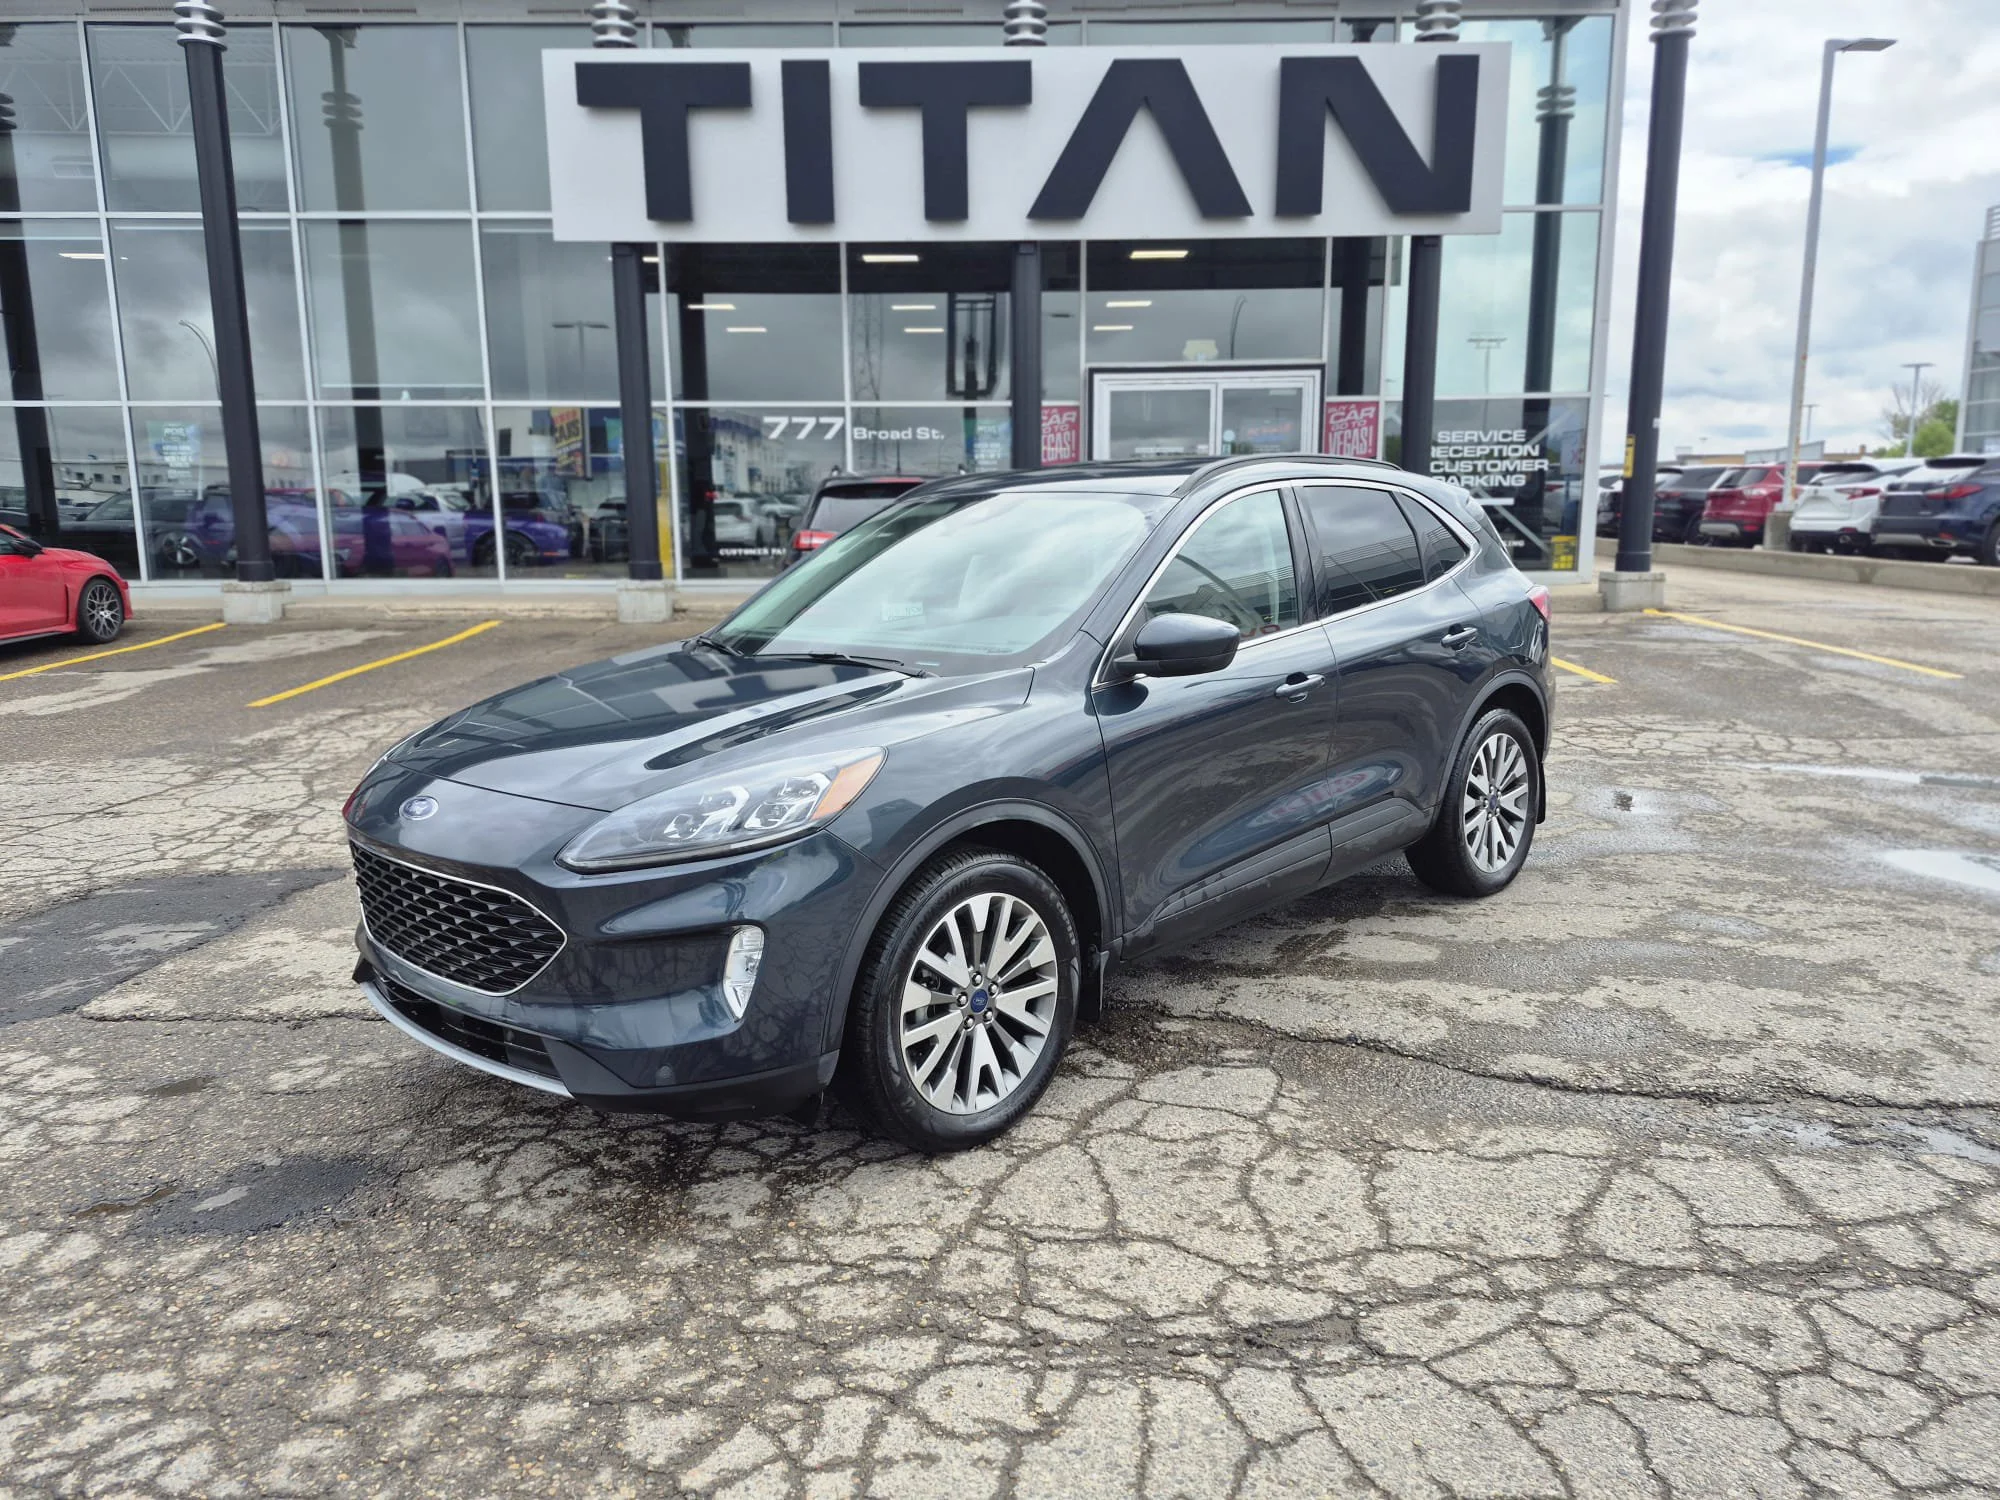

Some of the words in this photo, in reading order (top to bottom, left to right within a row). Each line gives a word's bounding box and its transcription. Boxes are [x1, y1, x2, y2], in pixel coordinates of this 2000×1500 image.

[576, 54, 1480, 225] TITAN
[1330, 407, 1377, 424] CAR
[763, 416, 845, 440] 777
[853, 427, 912, 440] Broad
[916, 426, 945, 440] St.
[1437, 429, 1527, 443] SERVICE
[1041, 429, 1076, 463] EGAS!
[1329, 425, 1373, 457] VEGAS!
[1430, 458, 1549, 473] CUSTOMER
